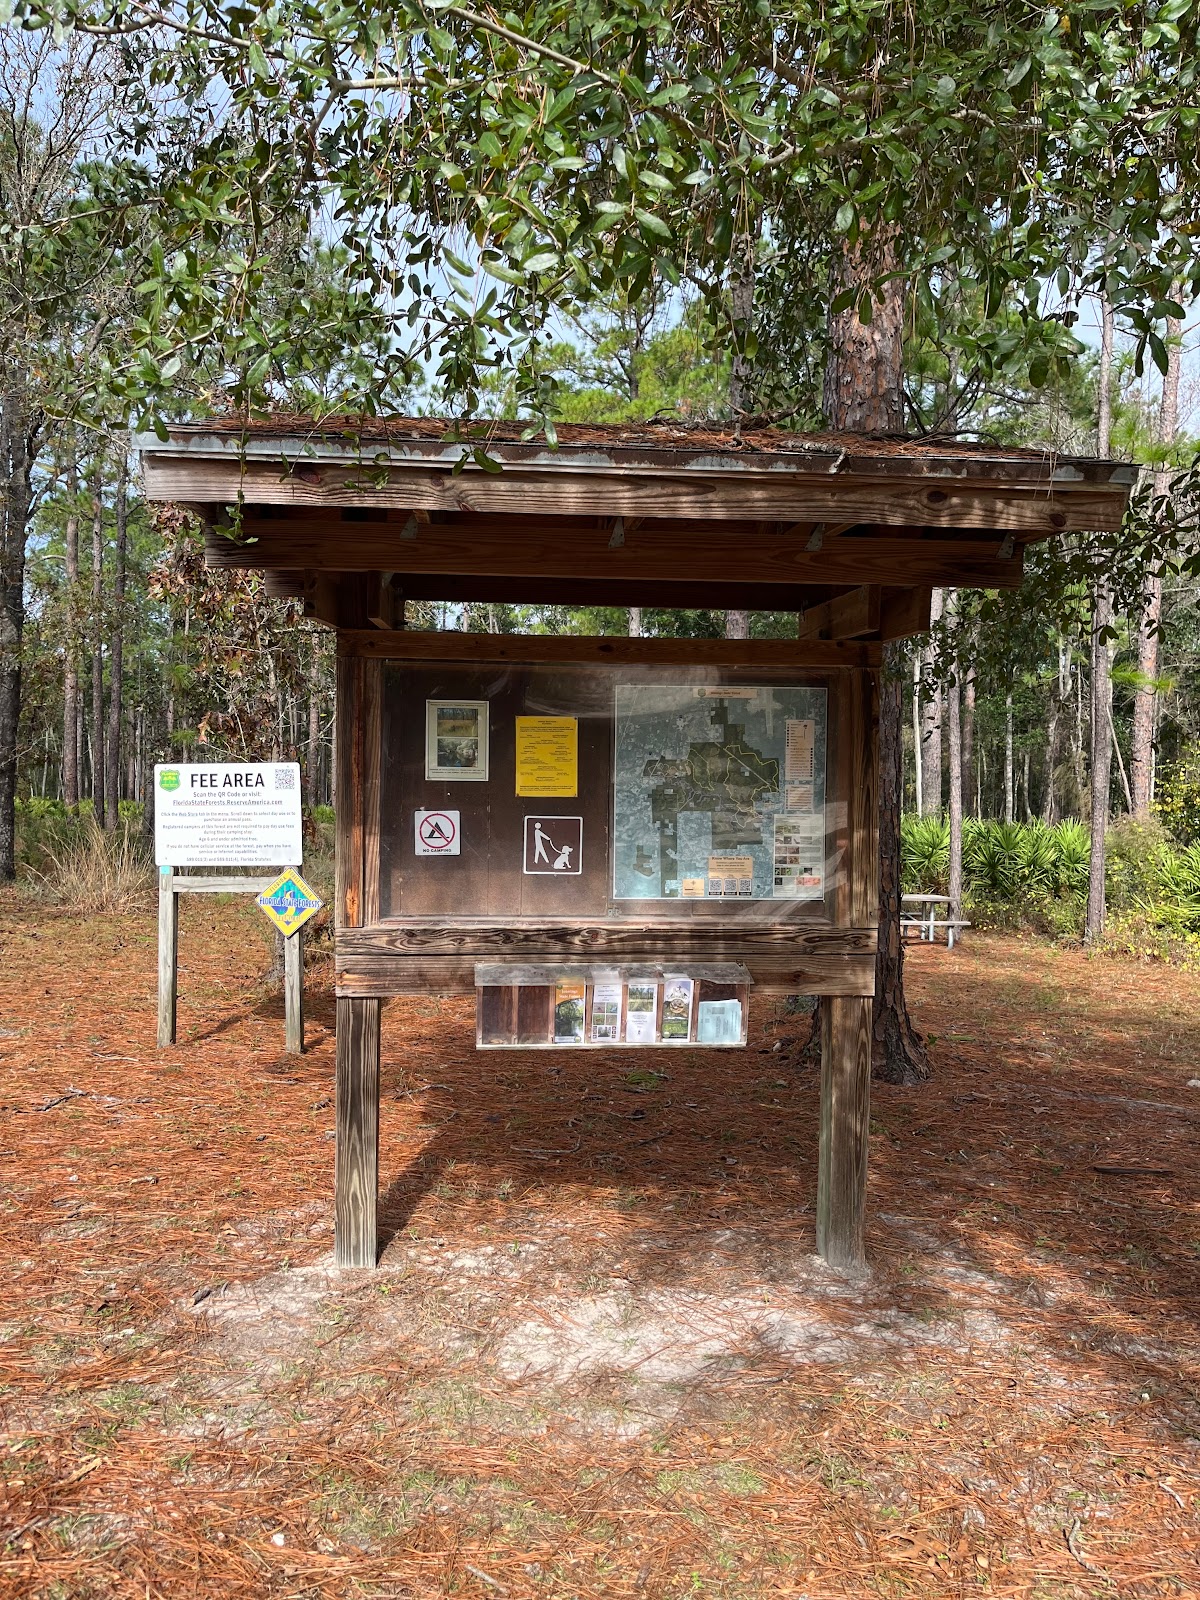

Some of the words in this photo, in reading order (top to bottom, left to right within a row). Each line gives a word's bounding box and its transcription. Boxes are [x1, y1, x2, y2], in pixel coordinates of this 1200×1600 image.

[190, 774, 218, 788] FEE
[222, 773, 265, 788] AREA
[270, 876, 287, 892] FLORIDA
[260, 896, 281, 906] FLORIDA
[282, 898, 298, 908] STATE
[298, 898, 320, 908] FORESTS
